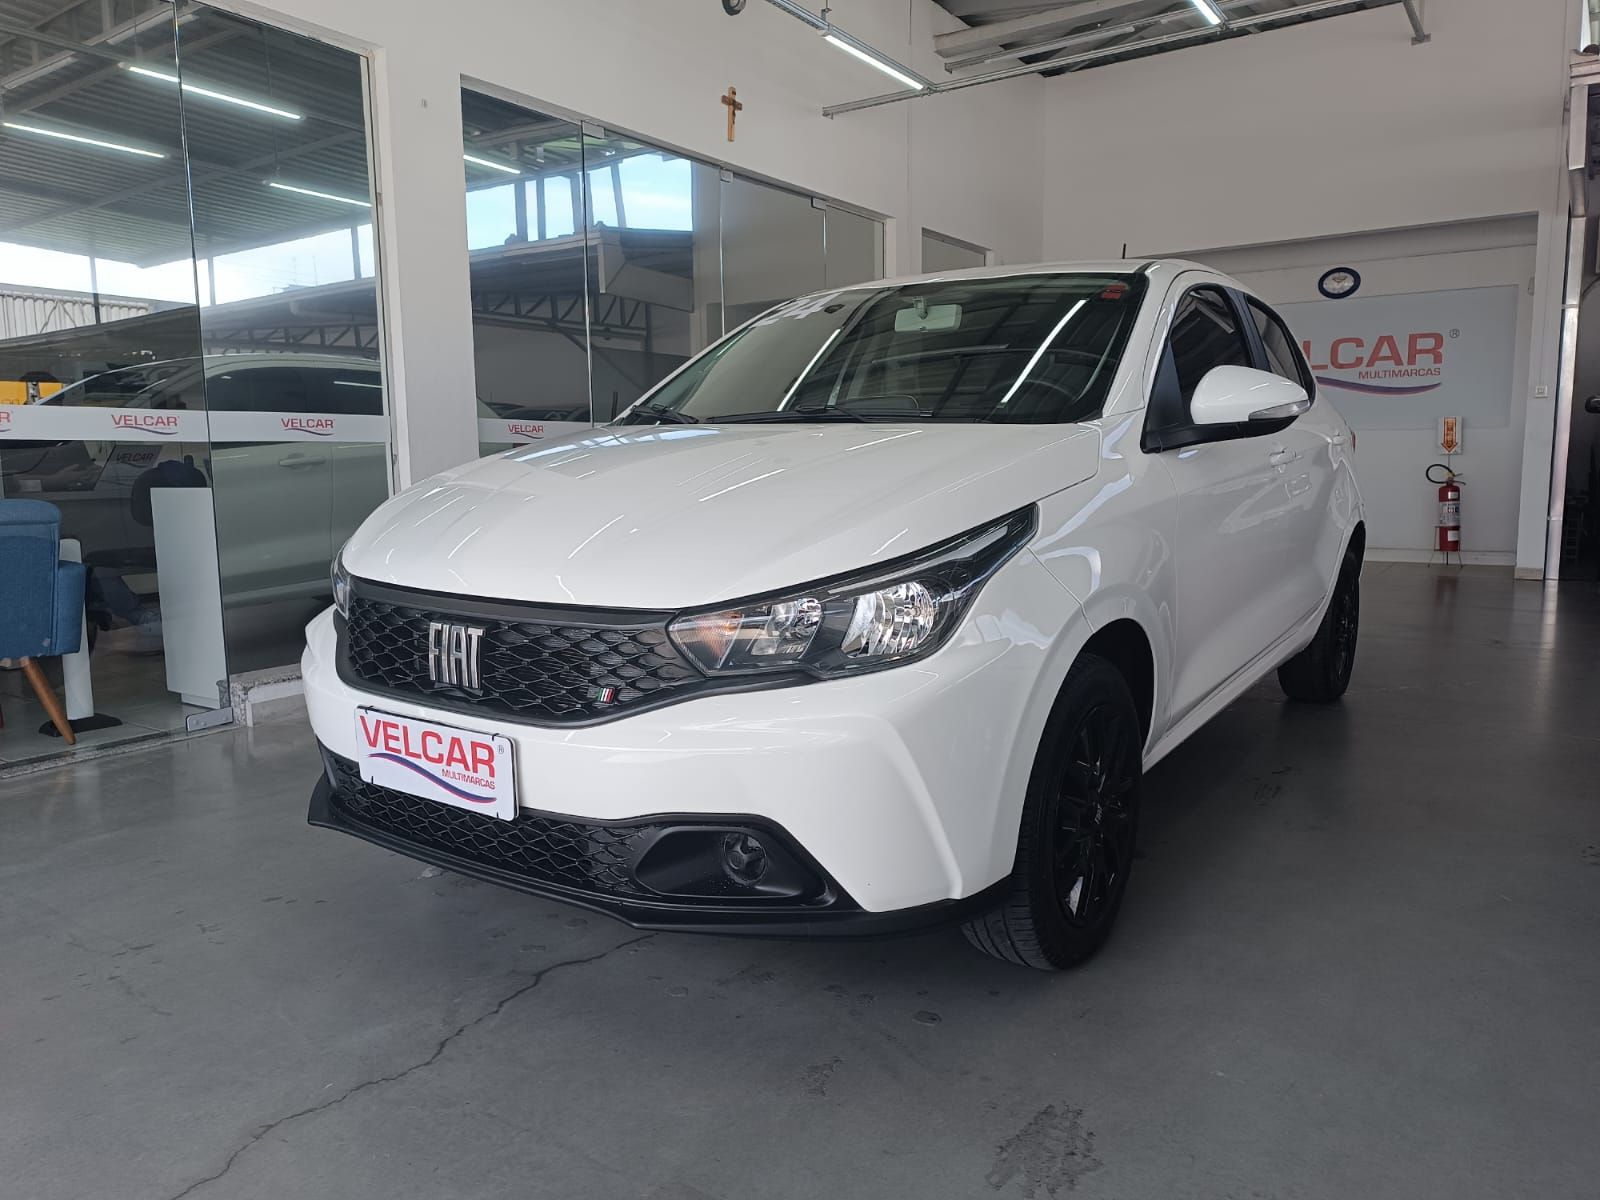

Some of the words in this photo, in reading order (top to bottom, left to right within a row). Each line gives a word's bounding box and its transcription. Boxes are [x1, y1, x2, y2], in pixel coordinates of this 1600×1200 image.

[1302, 332, 1444, 371] LCAR
[1358, 367, 1441, 380] MULTIMARCAS
[111, 414, 178, 427] VELCAR
[281, 418, 334, 429] VELCAR
[507, 424, 544, 433] VELCAR
[428, 622, 487, 689] FIAT
[359, 715, 496, 779] VELCAR
[442, 768, 496, 790] MULTIMARCAS
